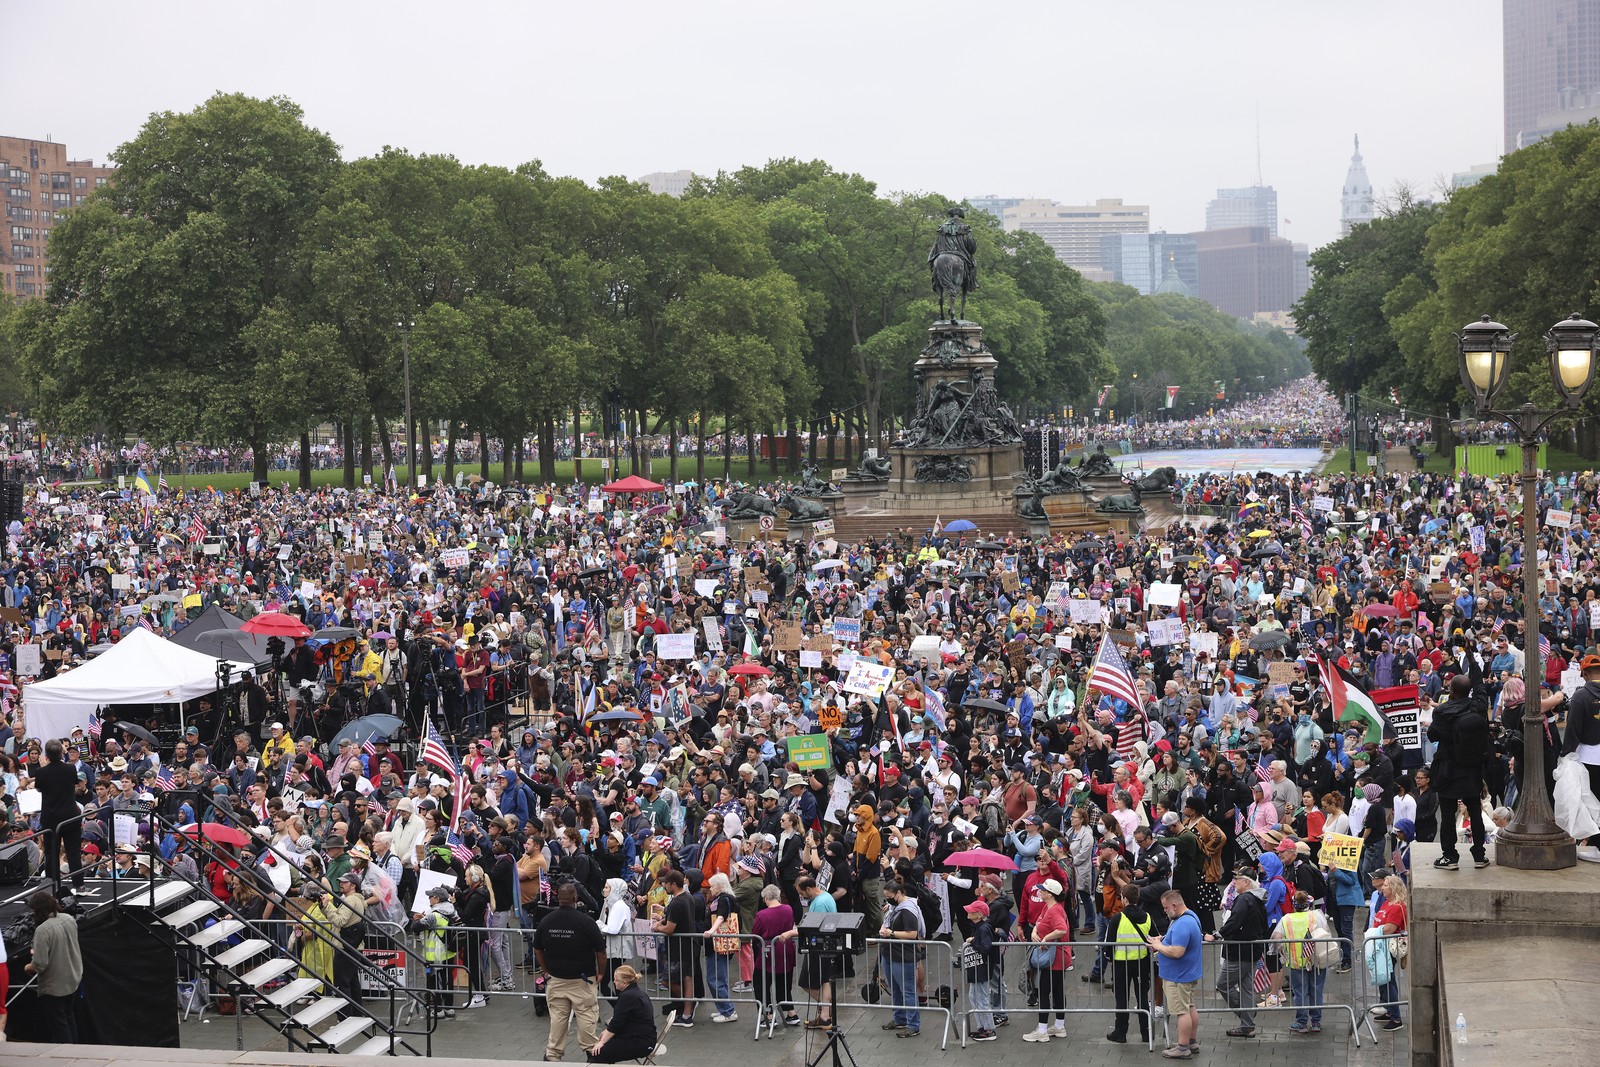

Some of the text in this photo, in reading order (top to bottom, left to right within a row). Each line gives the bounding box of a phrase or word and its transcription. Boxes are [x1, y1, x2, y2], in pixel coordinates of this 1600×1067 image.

[1392, 700, 1415, 708] Government
[822, 708, 837, 719] NO
[1337, 847, 1356, 857] ICE
